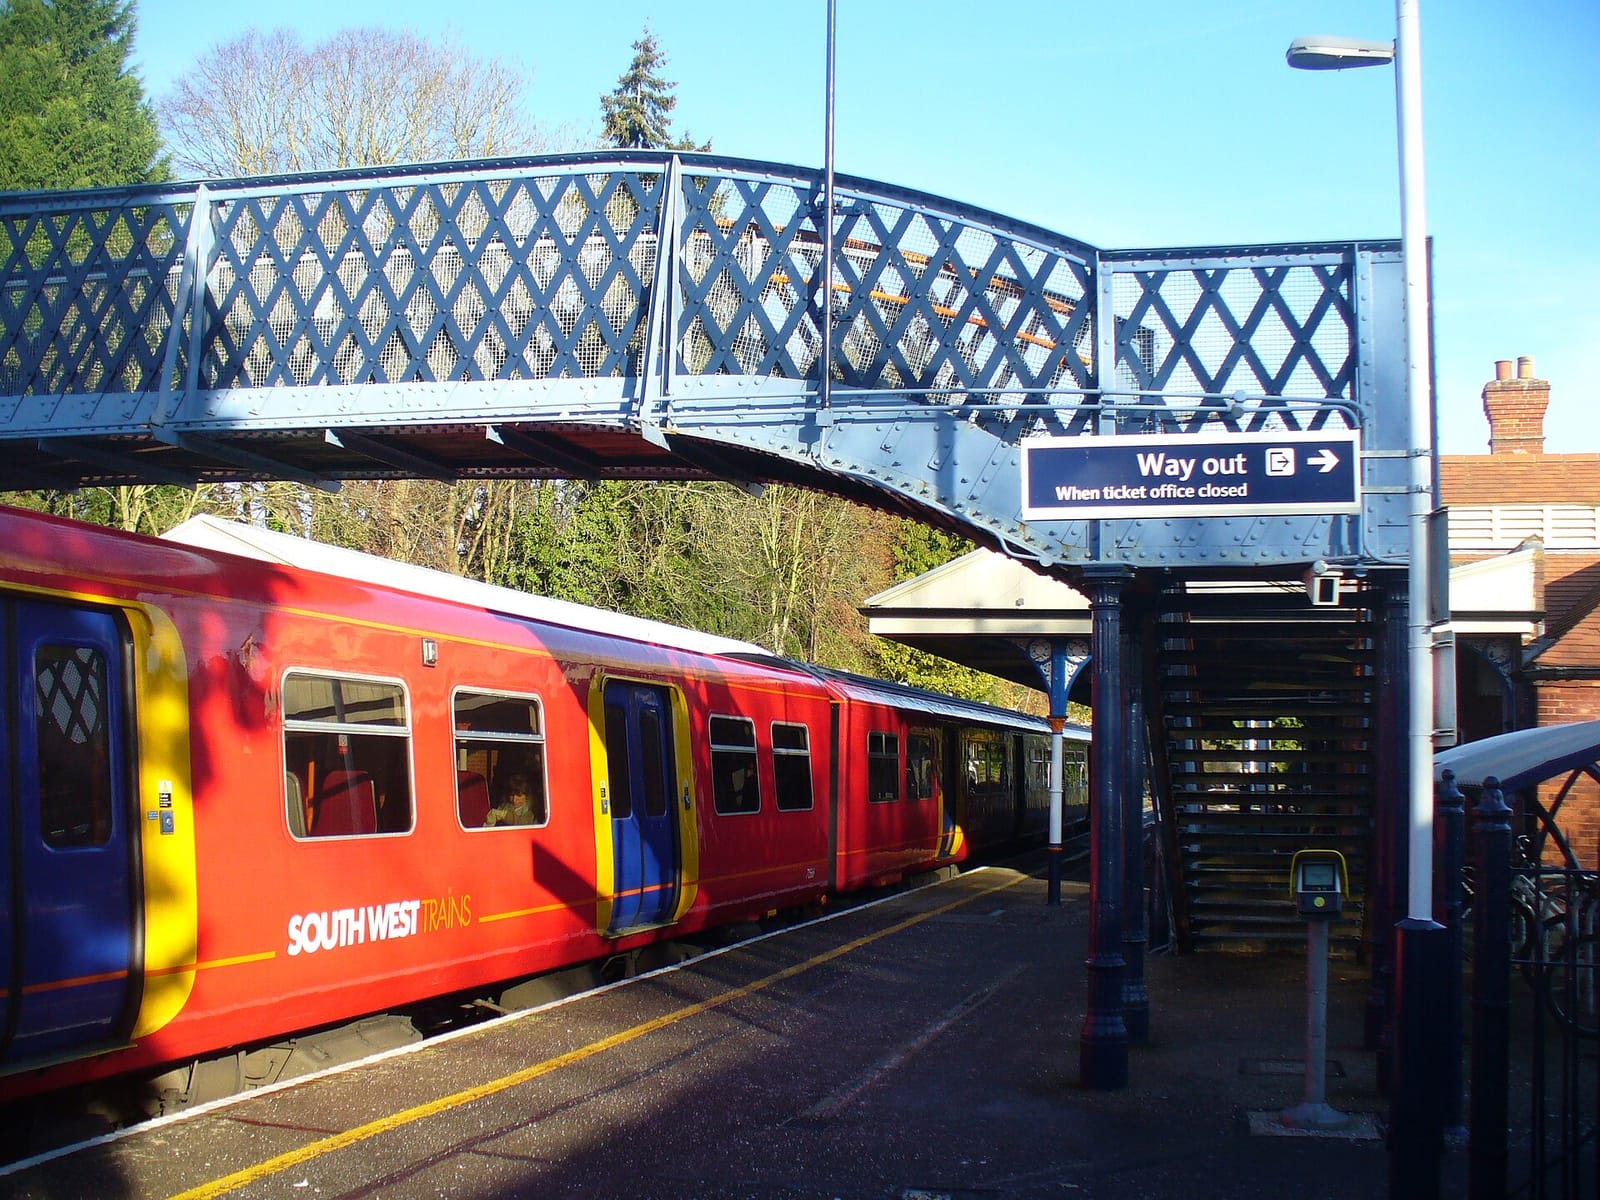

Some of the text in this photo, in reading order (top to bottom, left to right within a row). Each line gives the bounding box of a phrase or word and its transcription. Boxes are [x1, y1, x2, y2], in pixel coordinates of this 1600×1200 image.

[1137, 453, 1248, 481] Way out
[1056, 483, 1248, 501] When ticket office closed
[421, 894, 472, 933] TRAINS
